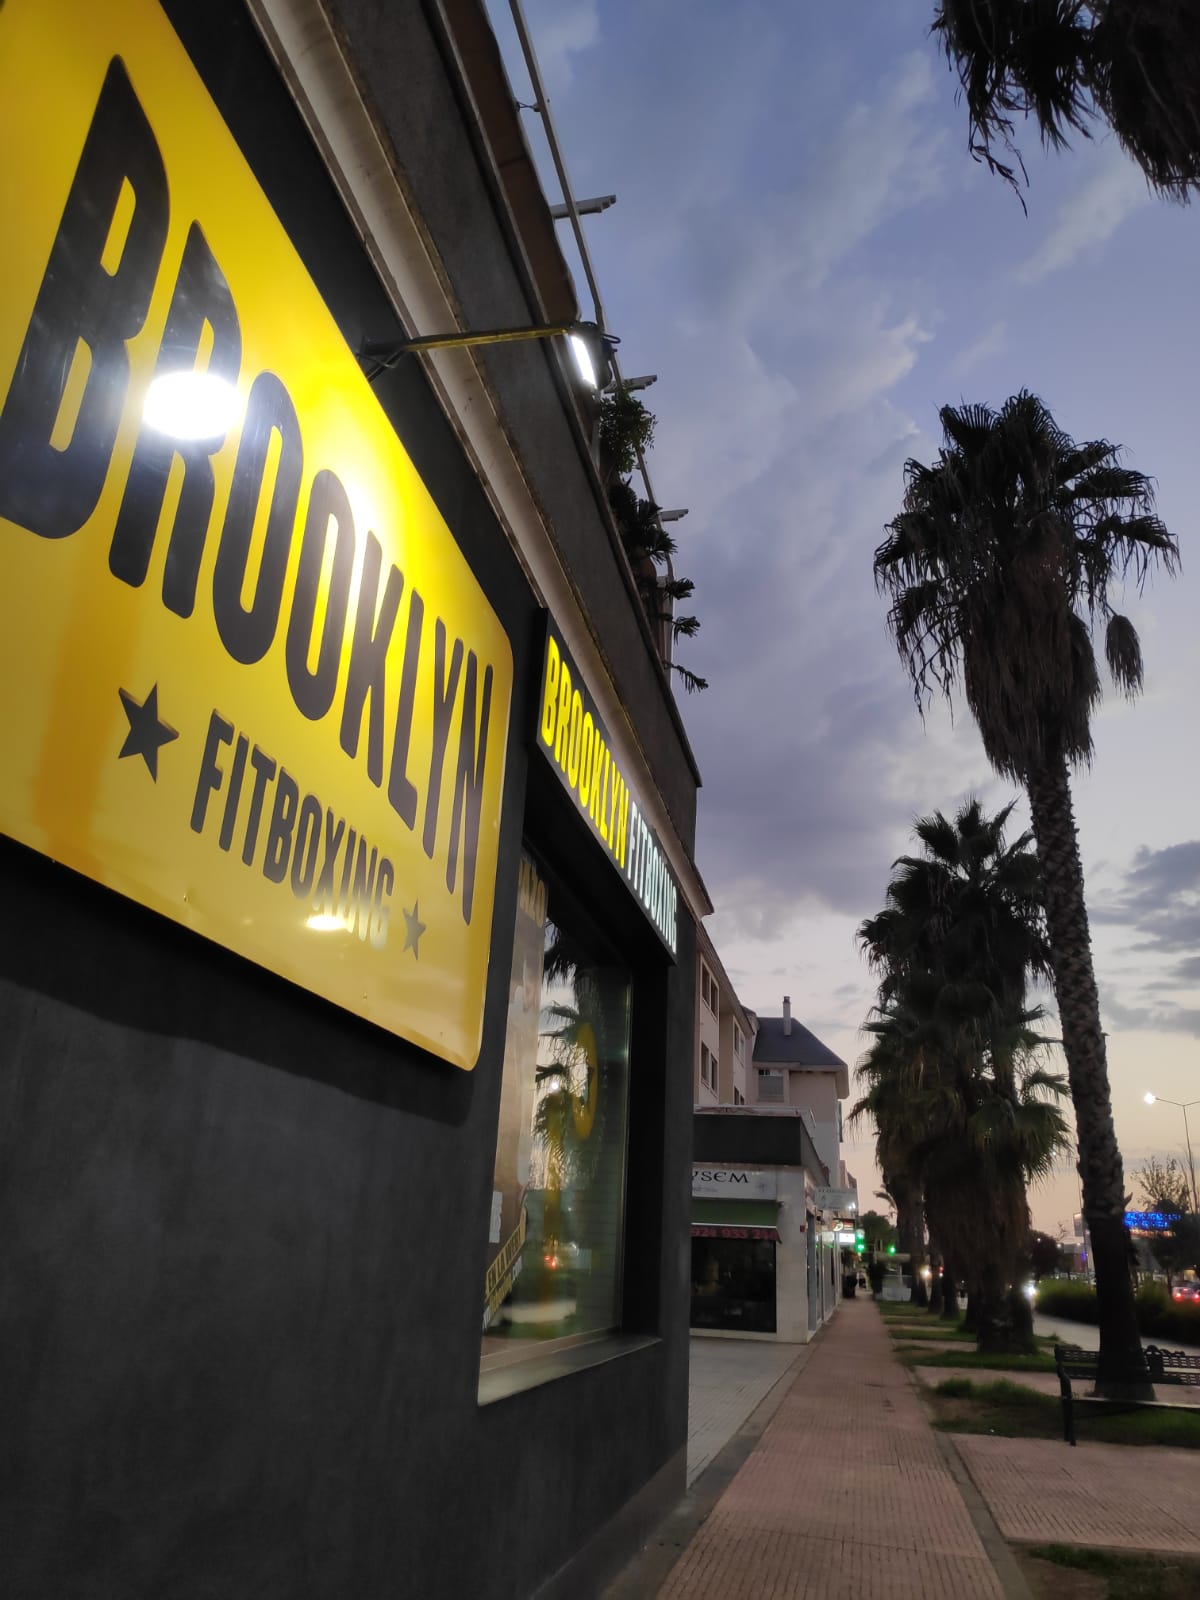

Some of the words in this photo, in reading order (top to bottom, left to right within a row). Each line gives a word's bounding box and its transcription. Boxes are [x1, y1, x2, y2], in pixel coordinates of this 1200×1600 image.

[0, 54, 494, 926] BROOKLYN
[190, 708, 395, 949] FITBOXING
[541, 635, 630, 869] BROOKLYN
[627, 801, 677, 954] FITBOXING
